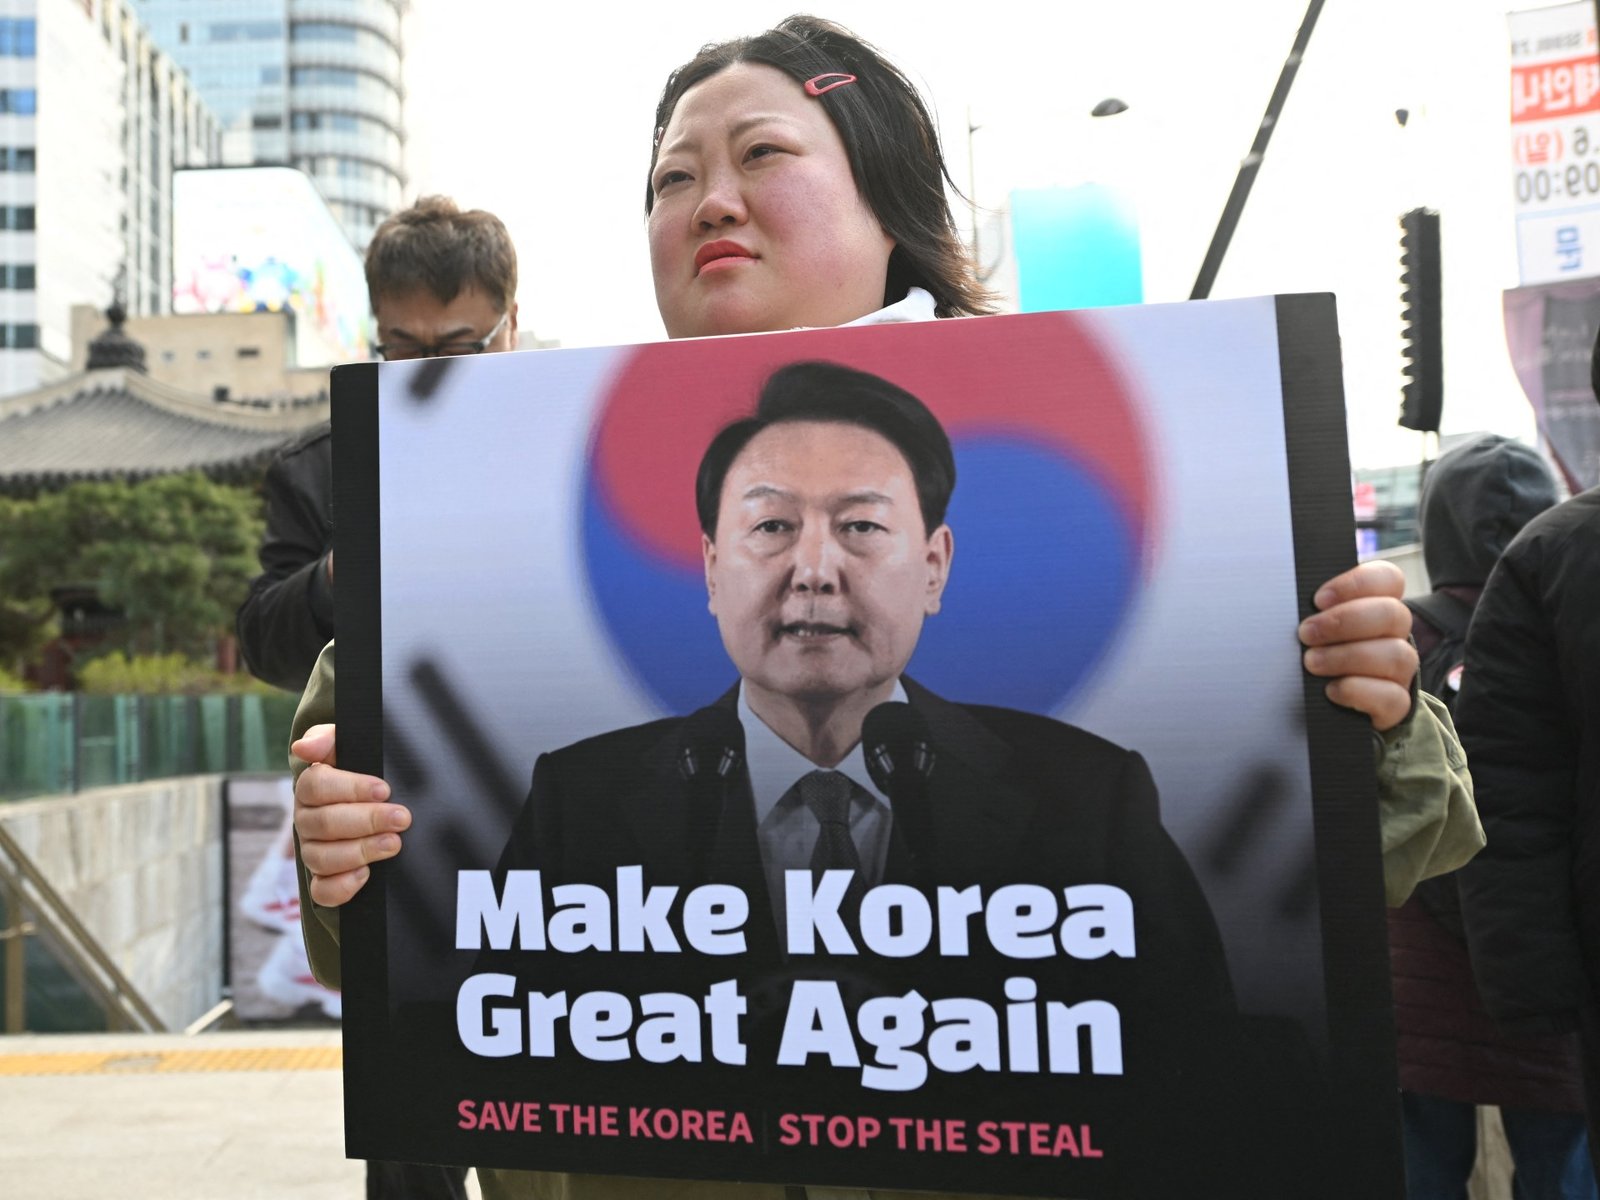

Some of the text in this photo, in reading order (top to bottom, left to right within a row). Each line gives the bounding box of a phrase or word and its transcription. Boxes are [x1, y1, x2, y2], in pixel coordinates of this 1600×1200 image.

[455, 865, 1136, 959] Make Korea
[456, 973, 1123, 1091] Great Again
[458, 1099, 1103, 1157] SAVE THE KOREA STOP THE STEAL
